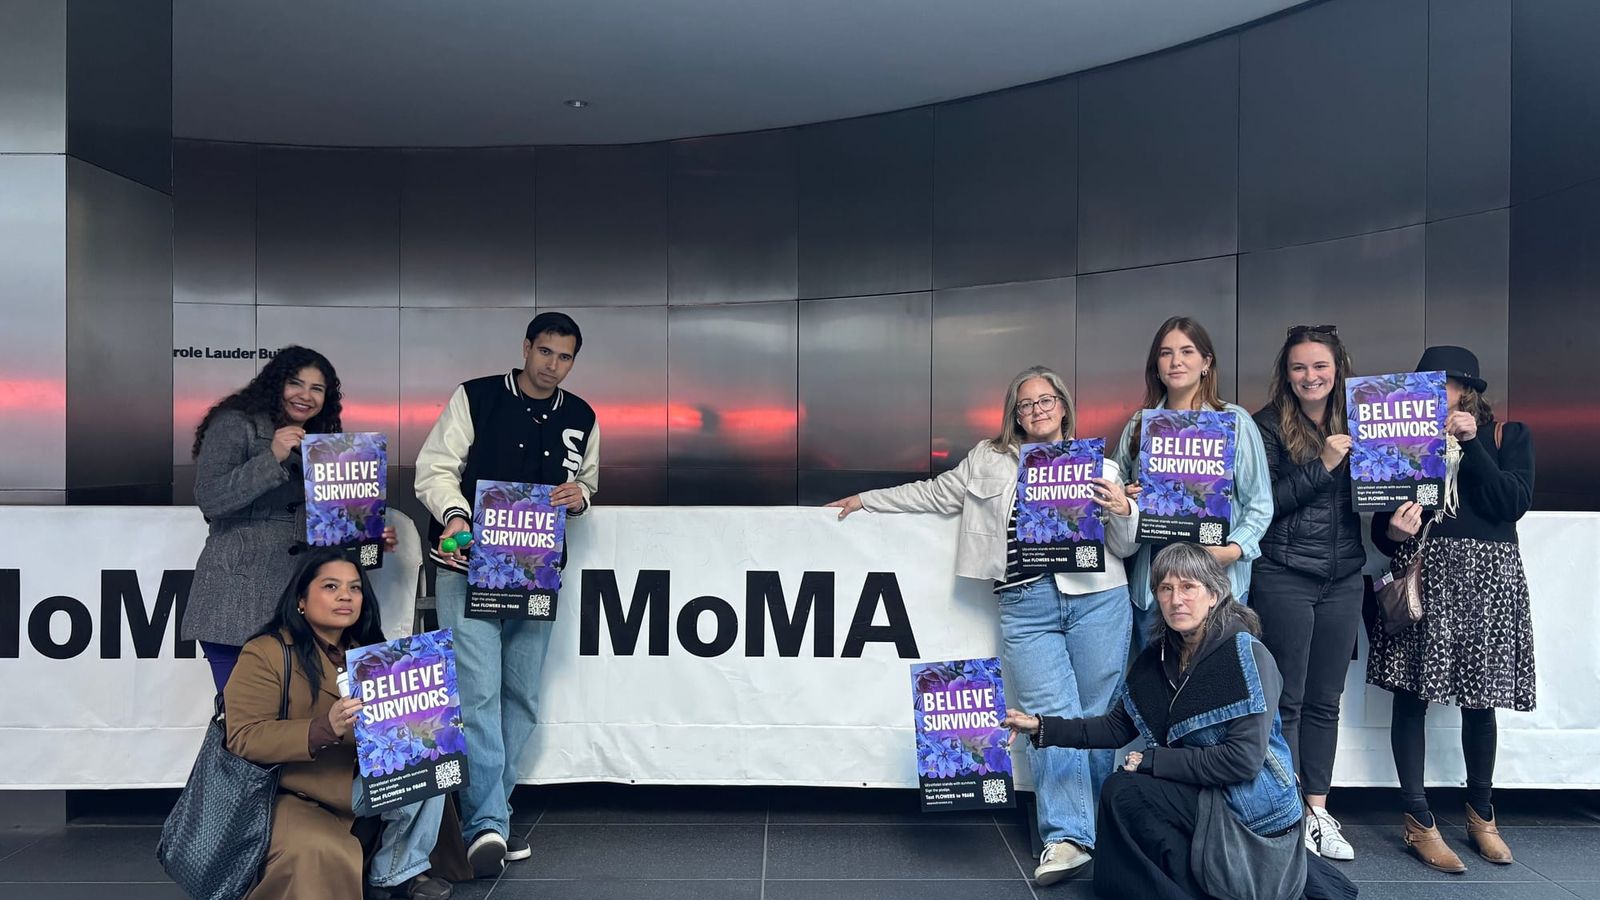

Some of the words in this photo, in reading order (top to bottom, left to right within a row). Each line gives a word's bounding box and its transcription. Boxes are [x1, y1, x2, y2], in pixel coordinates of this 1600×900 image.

[205, 347, 256, 359] Lauder
[1358, 399, 1436, 422] BELIEVE
[1358, 420, 1439, 440] SURVIVORS
[1151, 436, 1224, 458] BELIEVE
[314, 461, 378, 482] BELIEVE
[1027, 463, 1094, 484] BELIEVE
[1148, 456, 1225, 476] SURVIVORS
[314, 482, 380, 502] SURVIVORS
[1025, 483, 1095, 502] SURVIVORS
[484, 508, 555, 530] BELIEVE
[480, 529, 555, 549] SURVIVORS
[0, 569, 208, 660] oM
[579, 569, 921, 659] MoMA
[361, 663, 444, 702] BELIEVE
[363, 687, 449, 725] SURVIVORS
[923, 688, 995, 712] BELIEVE
[924, 710, 999, 732] SURVIVORS
[382, 788, 405, 799] FLOWERS
